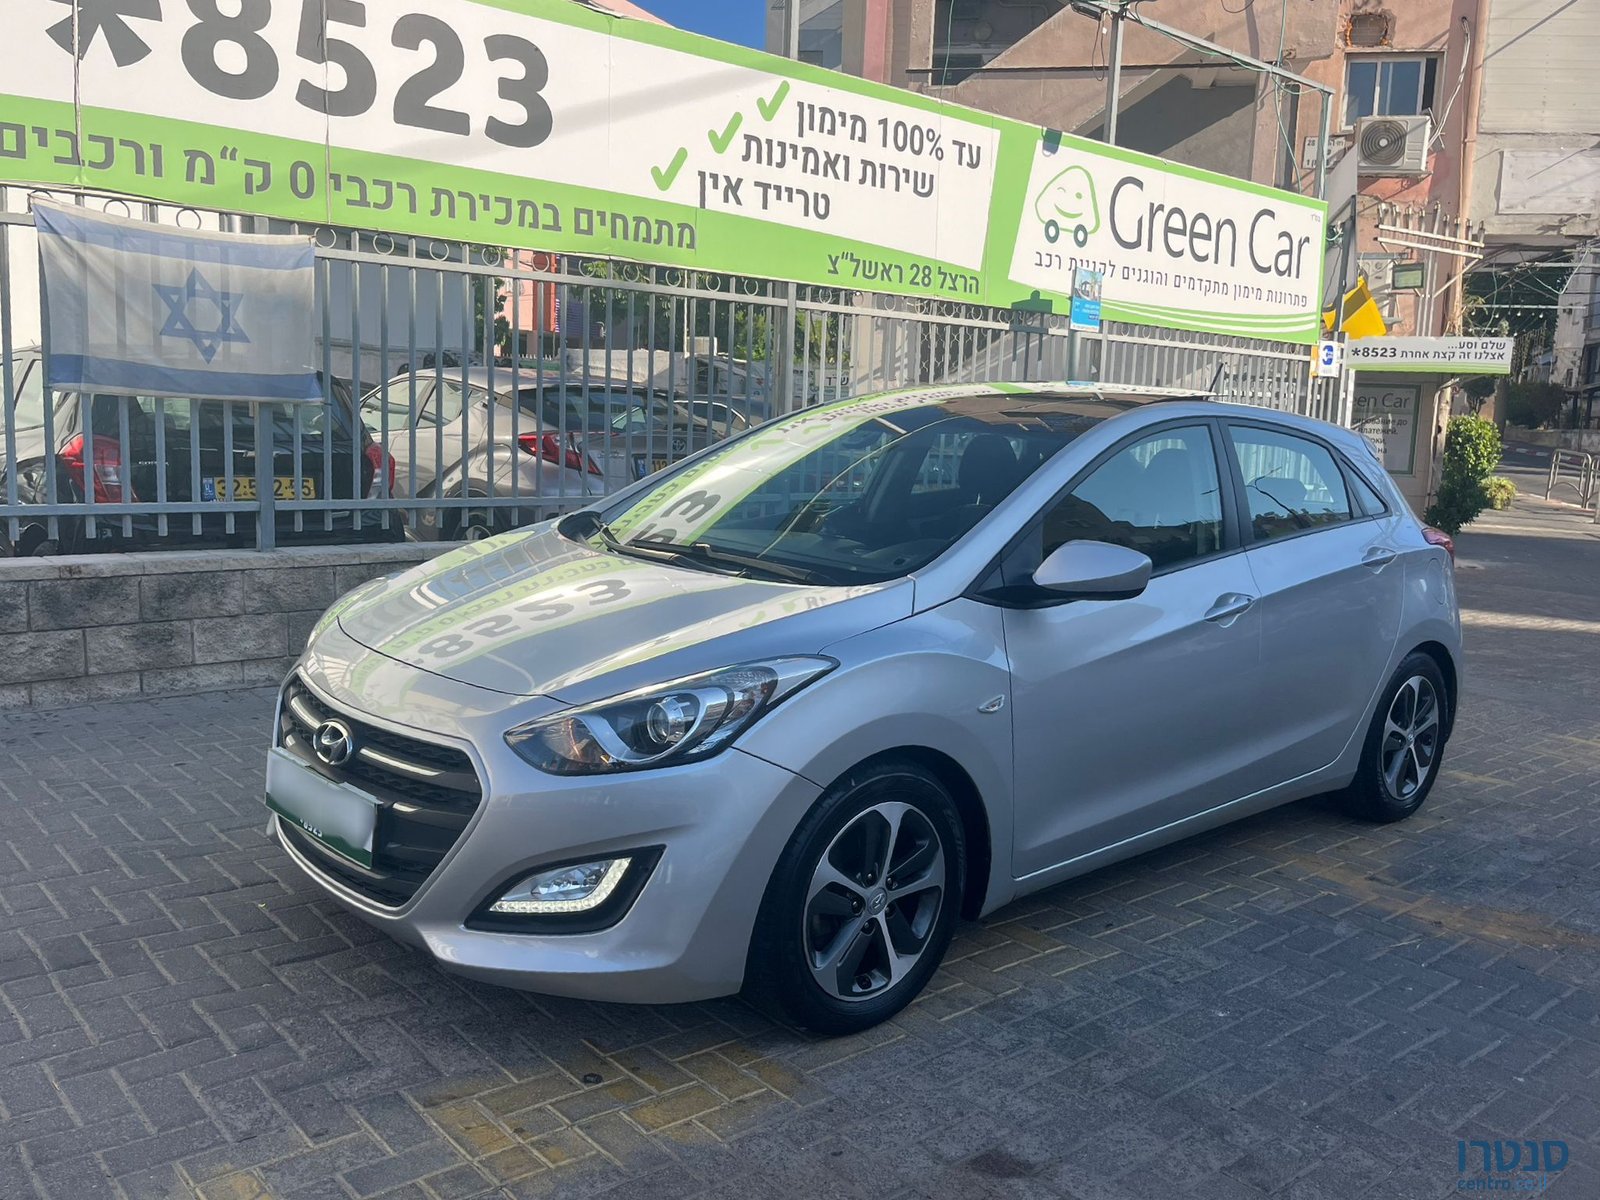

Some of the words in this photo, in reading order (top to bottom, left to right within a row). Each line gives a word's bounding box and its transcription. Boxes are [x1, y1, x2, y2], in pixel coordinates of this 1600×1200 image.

[796, 101, 867, 145] מימון
[0, 121, 163, 178] ורכבים
[878, 117, 944, 161] 100%
[952, 139, 981, 170] עד
[741, 133, 850, 182] ואמינות
[289, 160, 315, 200] 0
[328, 172, 417, 214] רכבי
[697, 170, 744, 210] אין
[859, 158, 935, 198] שירות
[430, 187, 562, 232] במכירת
[753, 180, 831, 220] טרייד
[574, 206, 695, 250] מתמחים
[1109, 176, 1237, 268] Green
[1249, 208, 1311, 279] Car
[909, 263, 932, 288] 28
[1034, 251, 1062, 270] רכב
[1122, 266, 1168, 286] והוגנים
[938, 263, 980, 295] הרצל
[1173, 274, 1229, 297] מתקדמים
[1233, 283, 1262, 301] מימון
[1266, 289, 1308, 308] פתרונות
[1400, 350, 1429, 359] אחרת
[1433, 350, 1455, 361] קצת
[1459, 351, 1471, 359] זה
[1474, 351, 1505, 360] אצלנו
[1481, 341, 1506, 350] שלם
[1382, 392, 1410, 408] Car
